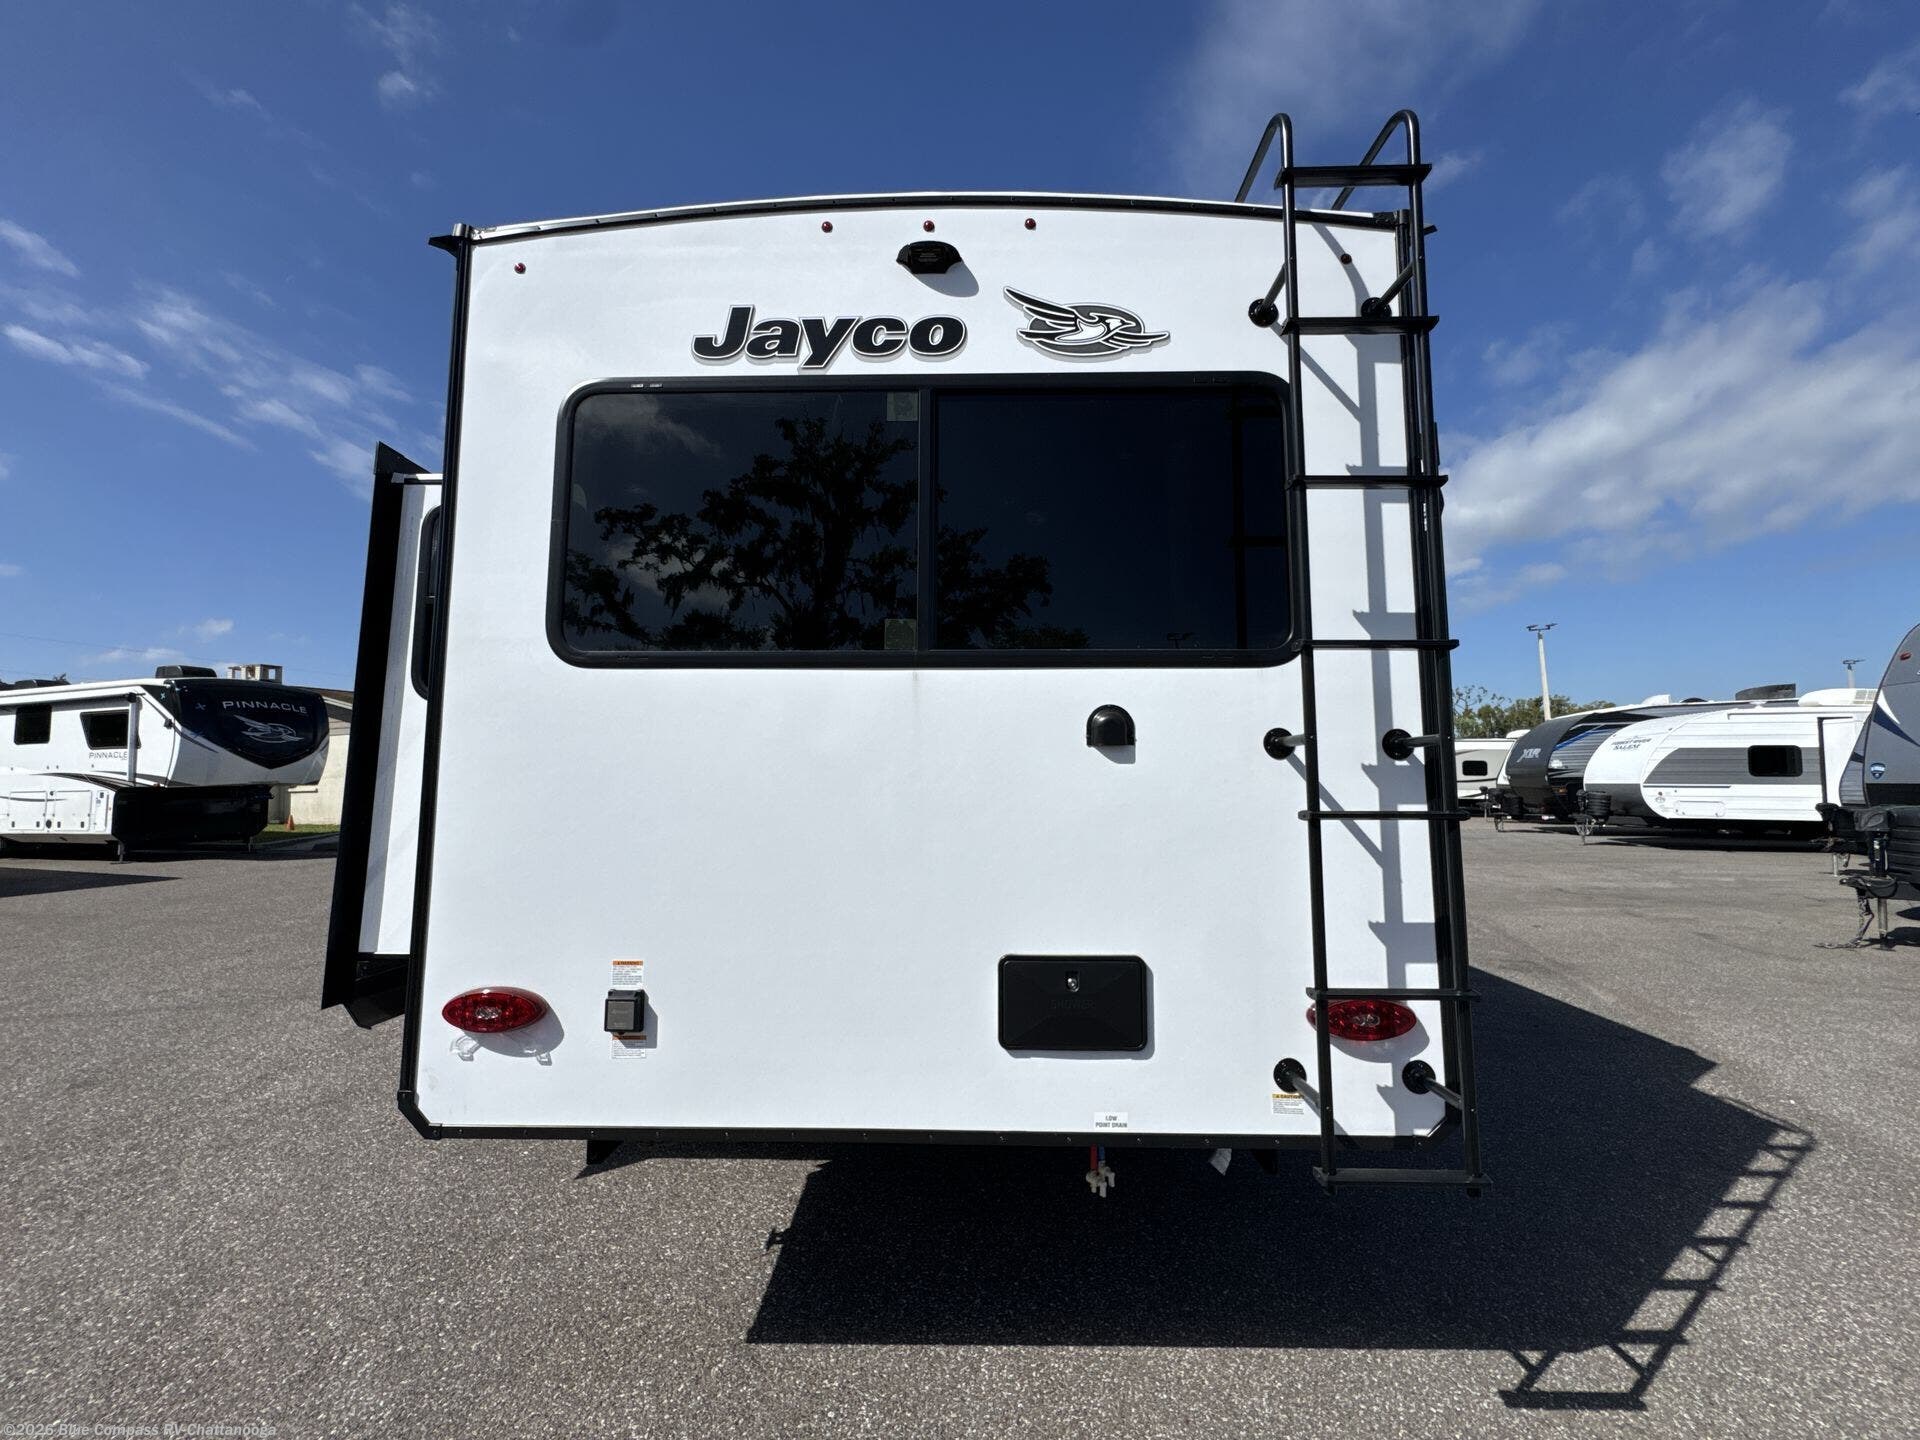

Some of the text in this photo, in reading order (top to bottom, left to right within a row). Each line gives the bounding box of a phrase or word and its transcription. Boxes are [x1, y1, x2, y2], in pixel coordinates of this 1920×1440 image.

[692, 303, 967, 372] Jayco
[222, 700, 308, 714] PINNACLE
[88, 751, 128, 760] PINNACLE
[1105, 1114, 1118, 1122] LOW
